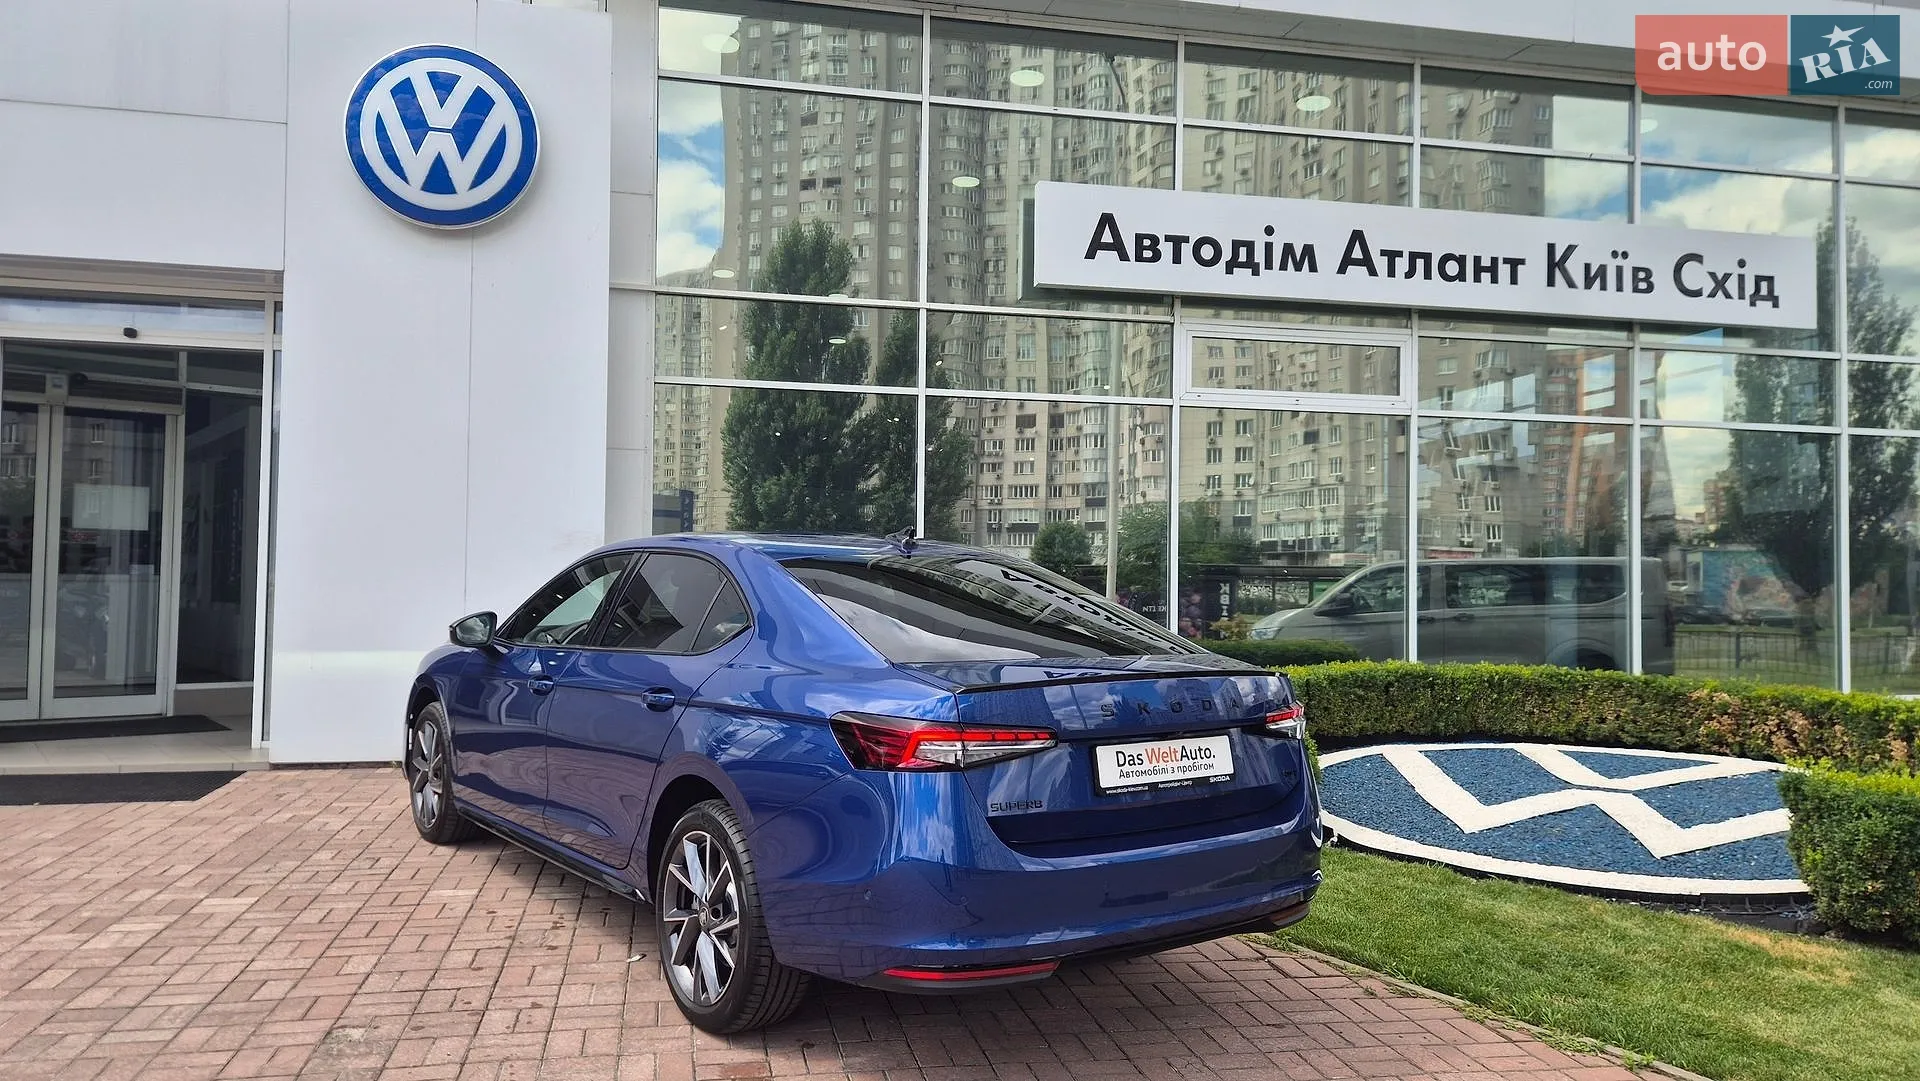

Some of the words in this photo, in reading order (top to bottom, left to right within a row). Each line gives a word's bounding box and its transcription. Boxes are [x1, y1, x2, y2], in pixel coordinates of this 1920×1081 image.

[1083, 212, 1319, 277] Автодім
[1336, 229, 1526, 285] Атлант
[1546, 242, 1655, 294] Київ
[1672, 252, 1780, 309] Схід
[1115, 750, 1144, 768] Das
[1145, 745, 1216, 765] WeltAuto.
[1118, 765, 1169, 779] Автомобілі
[1177, 762, 1215, 775] пробігом
[1209, 775, 1231, 783] SKODA
[990, 799, 1043, 812] SUPERB
